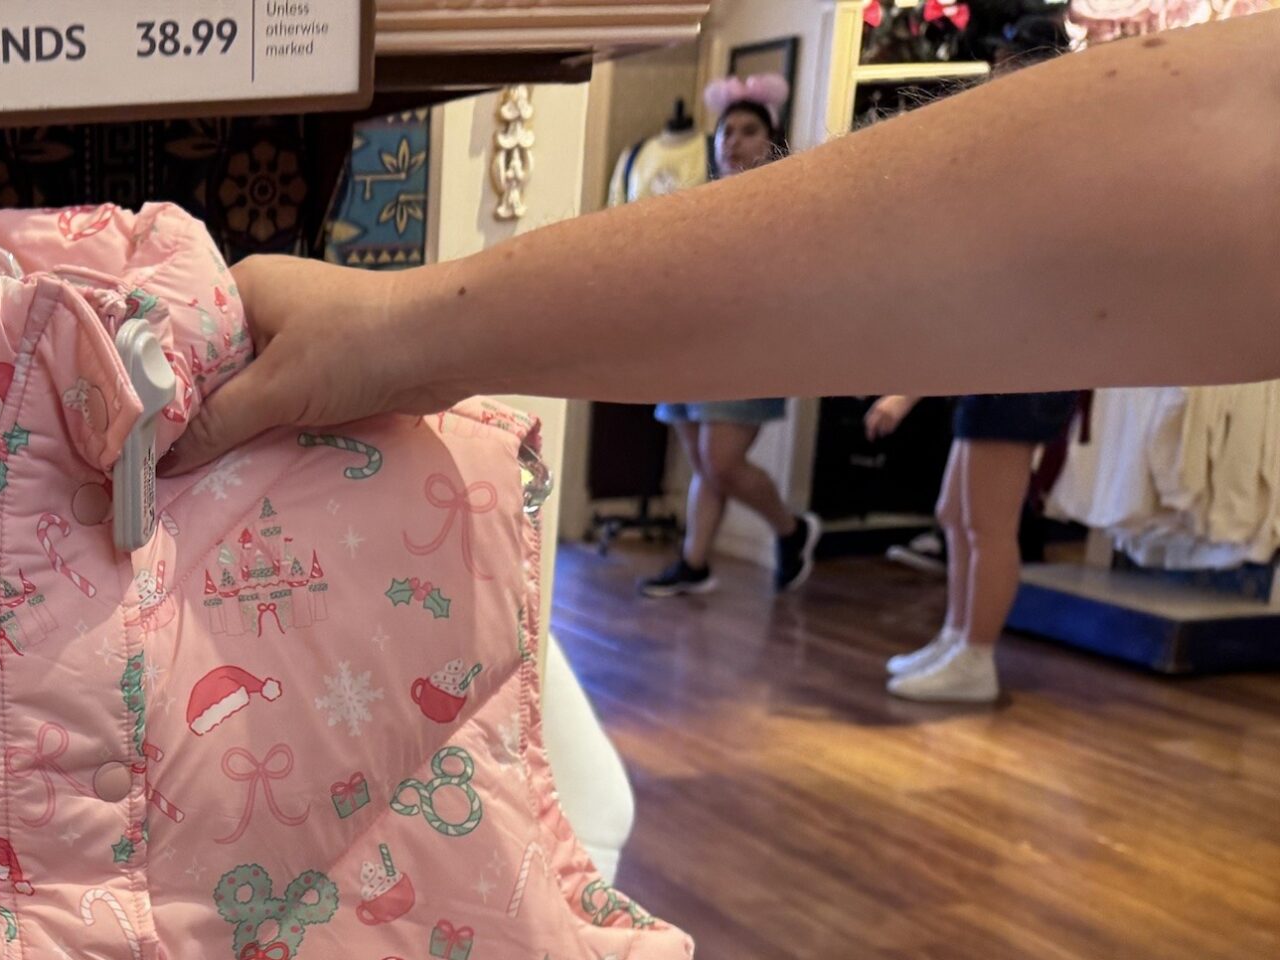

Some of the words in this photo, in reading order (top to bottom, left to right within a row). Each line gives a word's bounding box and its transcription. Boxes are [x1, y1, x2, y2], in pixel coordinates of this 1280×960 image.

[266, 0, 310, 17] Unless
[265, 18, 329, 37] otherwise
[136, 17, 238, 58] 38.99
[265, 38, 314, 57] marked
